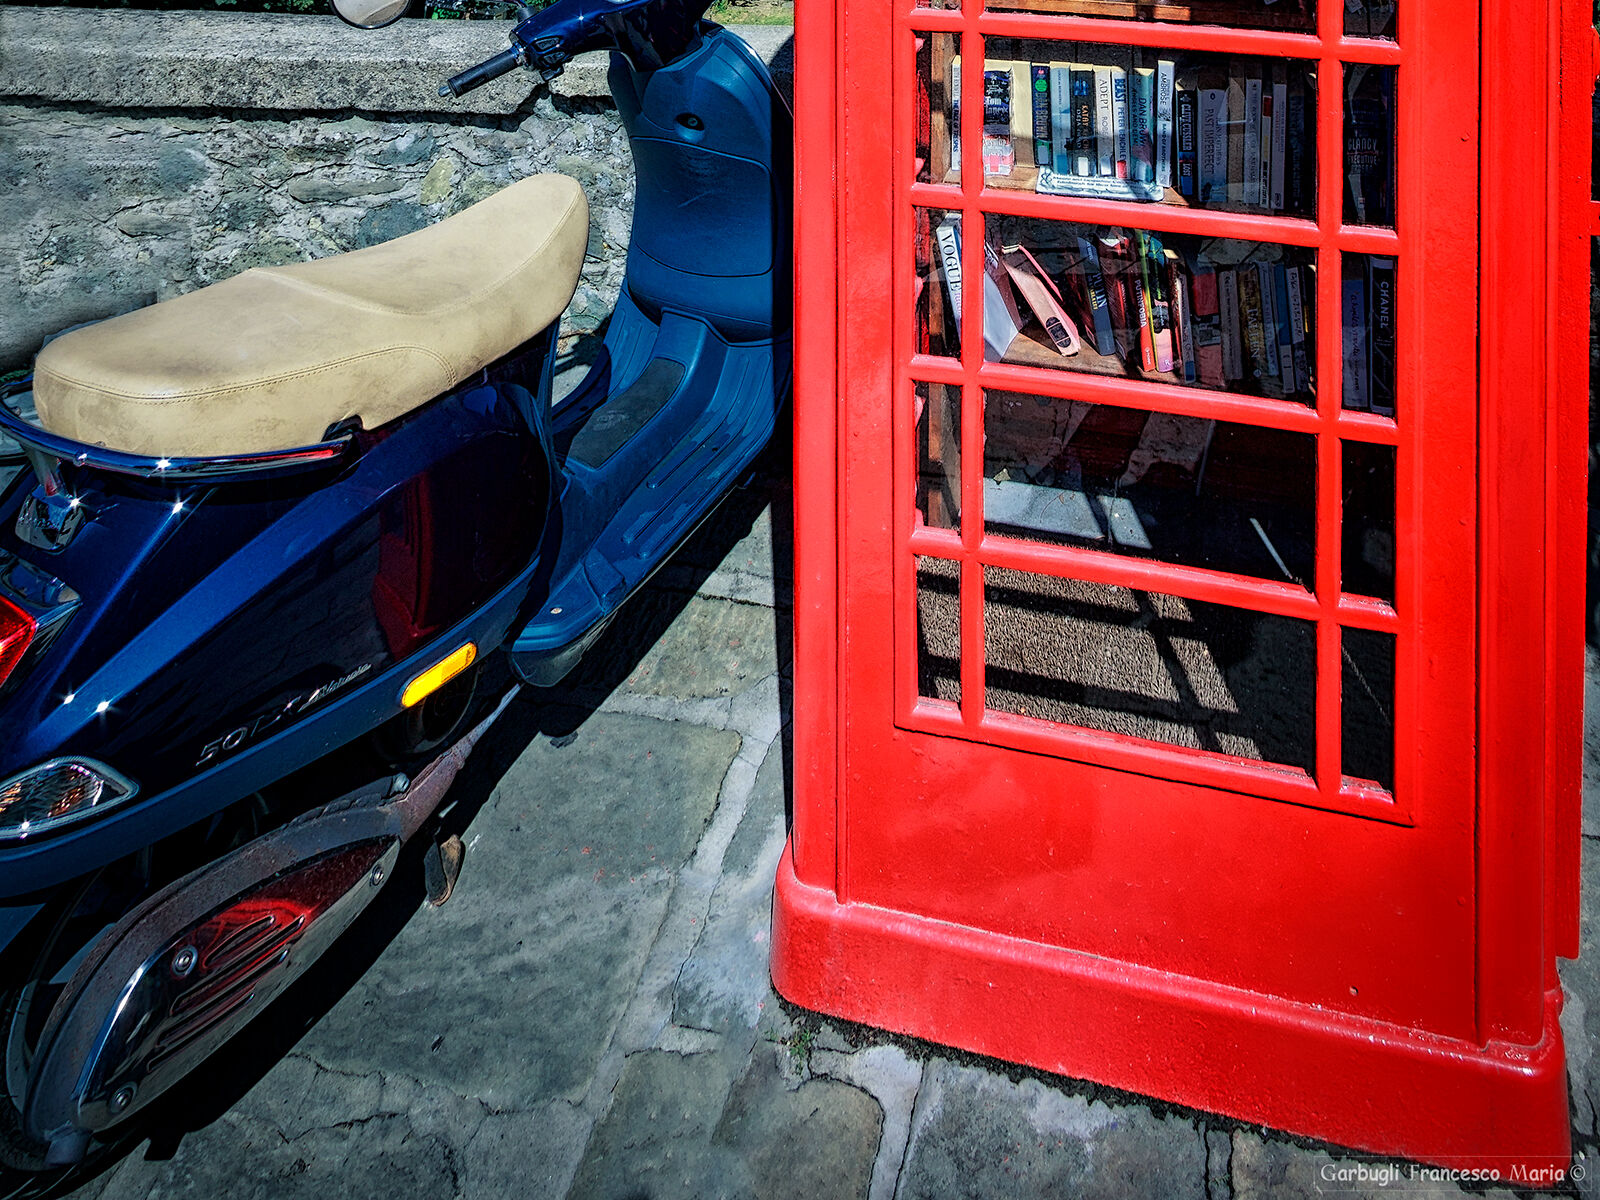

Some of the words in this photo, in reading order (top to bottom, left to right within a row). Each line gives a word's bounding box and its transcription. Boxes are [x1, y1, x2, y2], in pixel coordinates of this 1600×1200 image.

[1098, 78, 1108, 109] ADEPT
[1114, 78, 1125, 102] BEAST
[1117, 107, 1125, 127] PETER
[1138, 98, 1146, 116] DAN
[1181, 103, 1191, 123] CLIVE
[1204, 108, 1214, 127] PAST
[1182, 123, 1192, 150] CUSSLER
[1204, 130, 1214, 174] IMPERFECT
[1182, 162, 1191, 176] LOST
[940, 233, 962, 291] VOGUE
[1092, 273, 1107, 308] PUTIN
[1133, 278, 1147, 328] PUTINFOBIA
[1379, 281, 1389, 328] CHANEL
[1246, 307, 1261, 358] FALLEN
